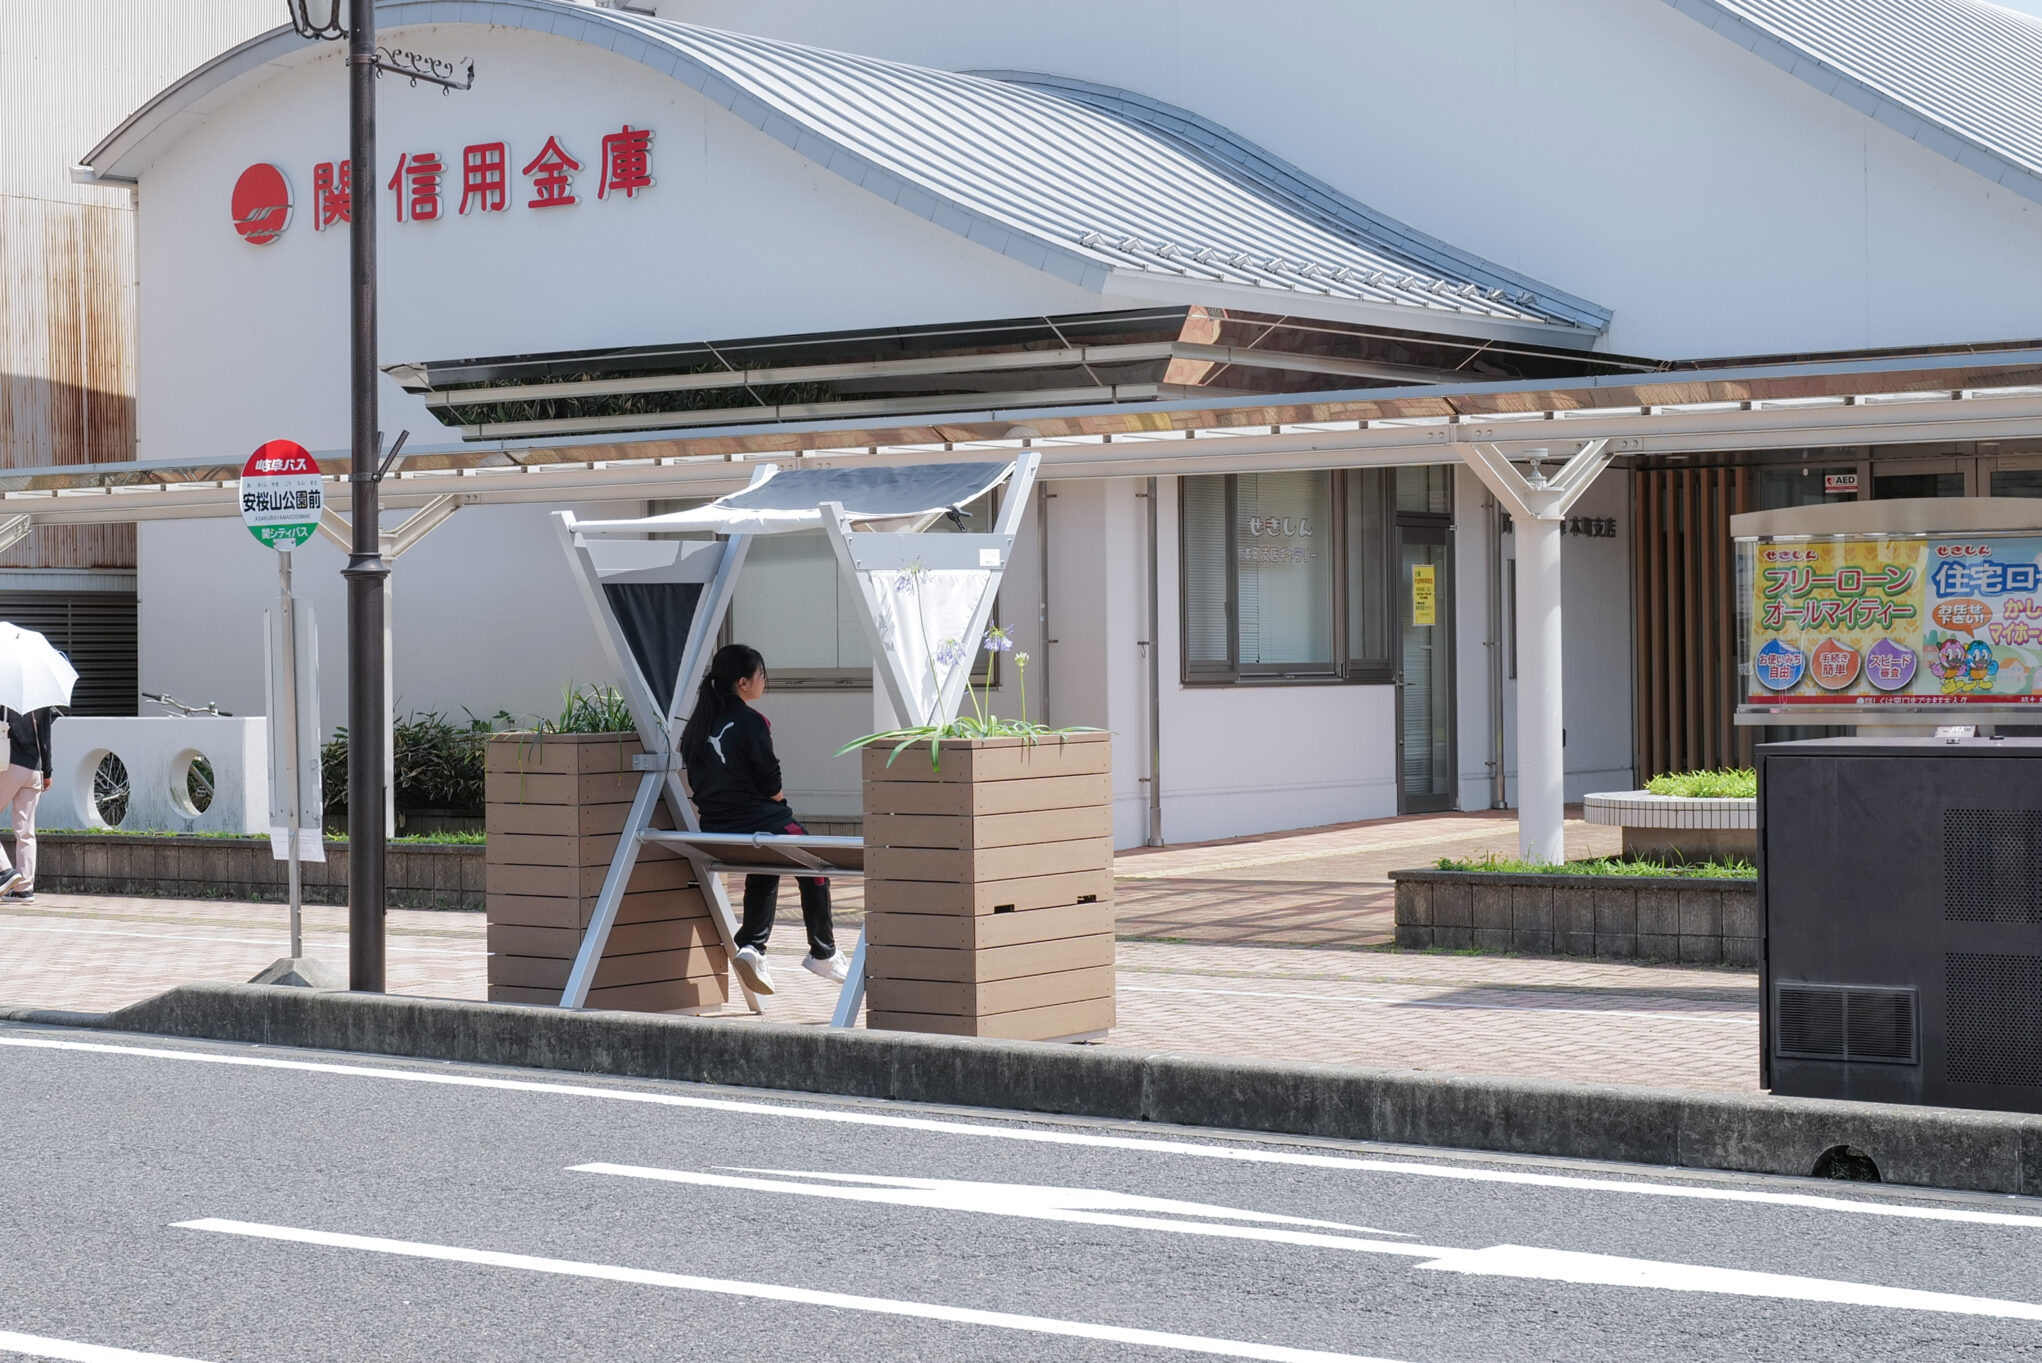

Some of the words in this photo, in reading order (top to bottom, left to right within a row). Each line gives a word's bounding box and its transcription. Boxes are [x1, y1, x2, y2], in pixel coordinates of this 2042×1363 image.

[313, 124, 654, 232] 関信用金庫
[255, 458, 307, 472] 岐阜バス
[1836, 476, 1855, 484] AED
[243, 489, 321, 512] 安桜山公園前
[262, 526, 309, 539] 関シティバス
[1249, 516, 1313, 537] せきしん
[1765, 550, 1818, 561] せきしん
[1936, 545, 1992, 558] せきしん
[1764, 567, 1913, 594] フリーローン
[1935, 563, 2042, 594] 住宅ロ
[1763, 599, 1913, 625] オールマイティー
[1938, 604, 1983, 614] お任せ
[1989, 621, 2042, 645] マイホー
[1759, 653, 1802, 665] お使いみち
[1820, 652, 1850, 664] 手続き
[1869, 654, 1911, 668] スピード
[1769, 666, 1792, 679] 自由
[1822, 664, 1847, 677] 簡単
[1879, 667, 1901, 679] 審査
